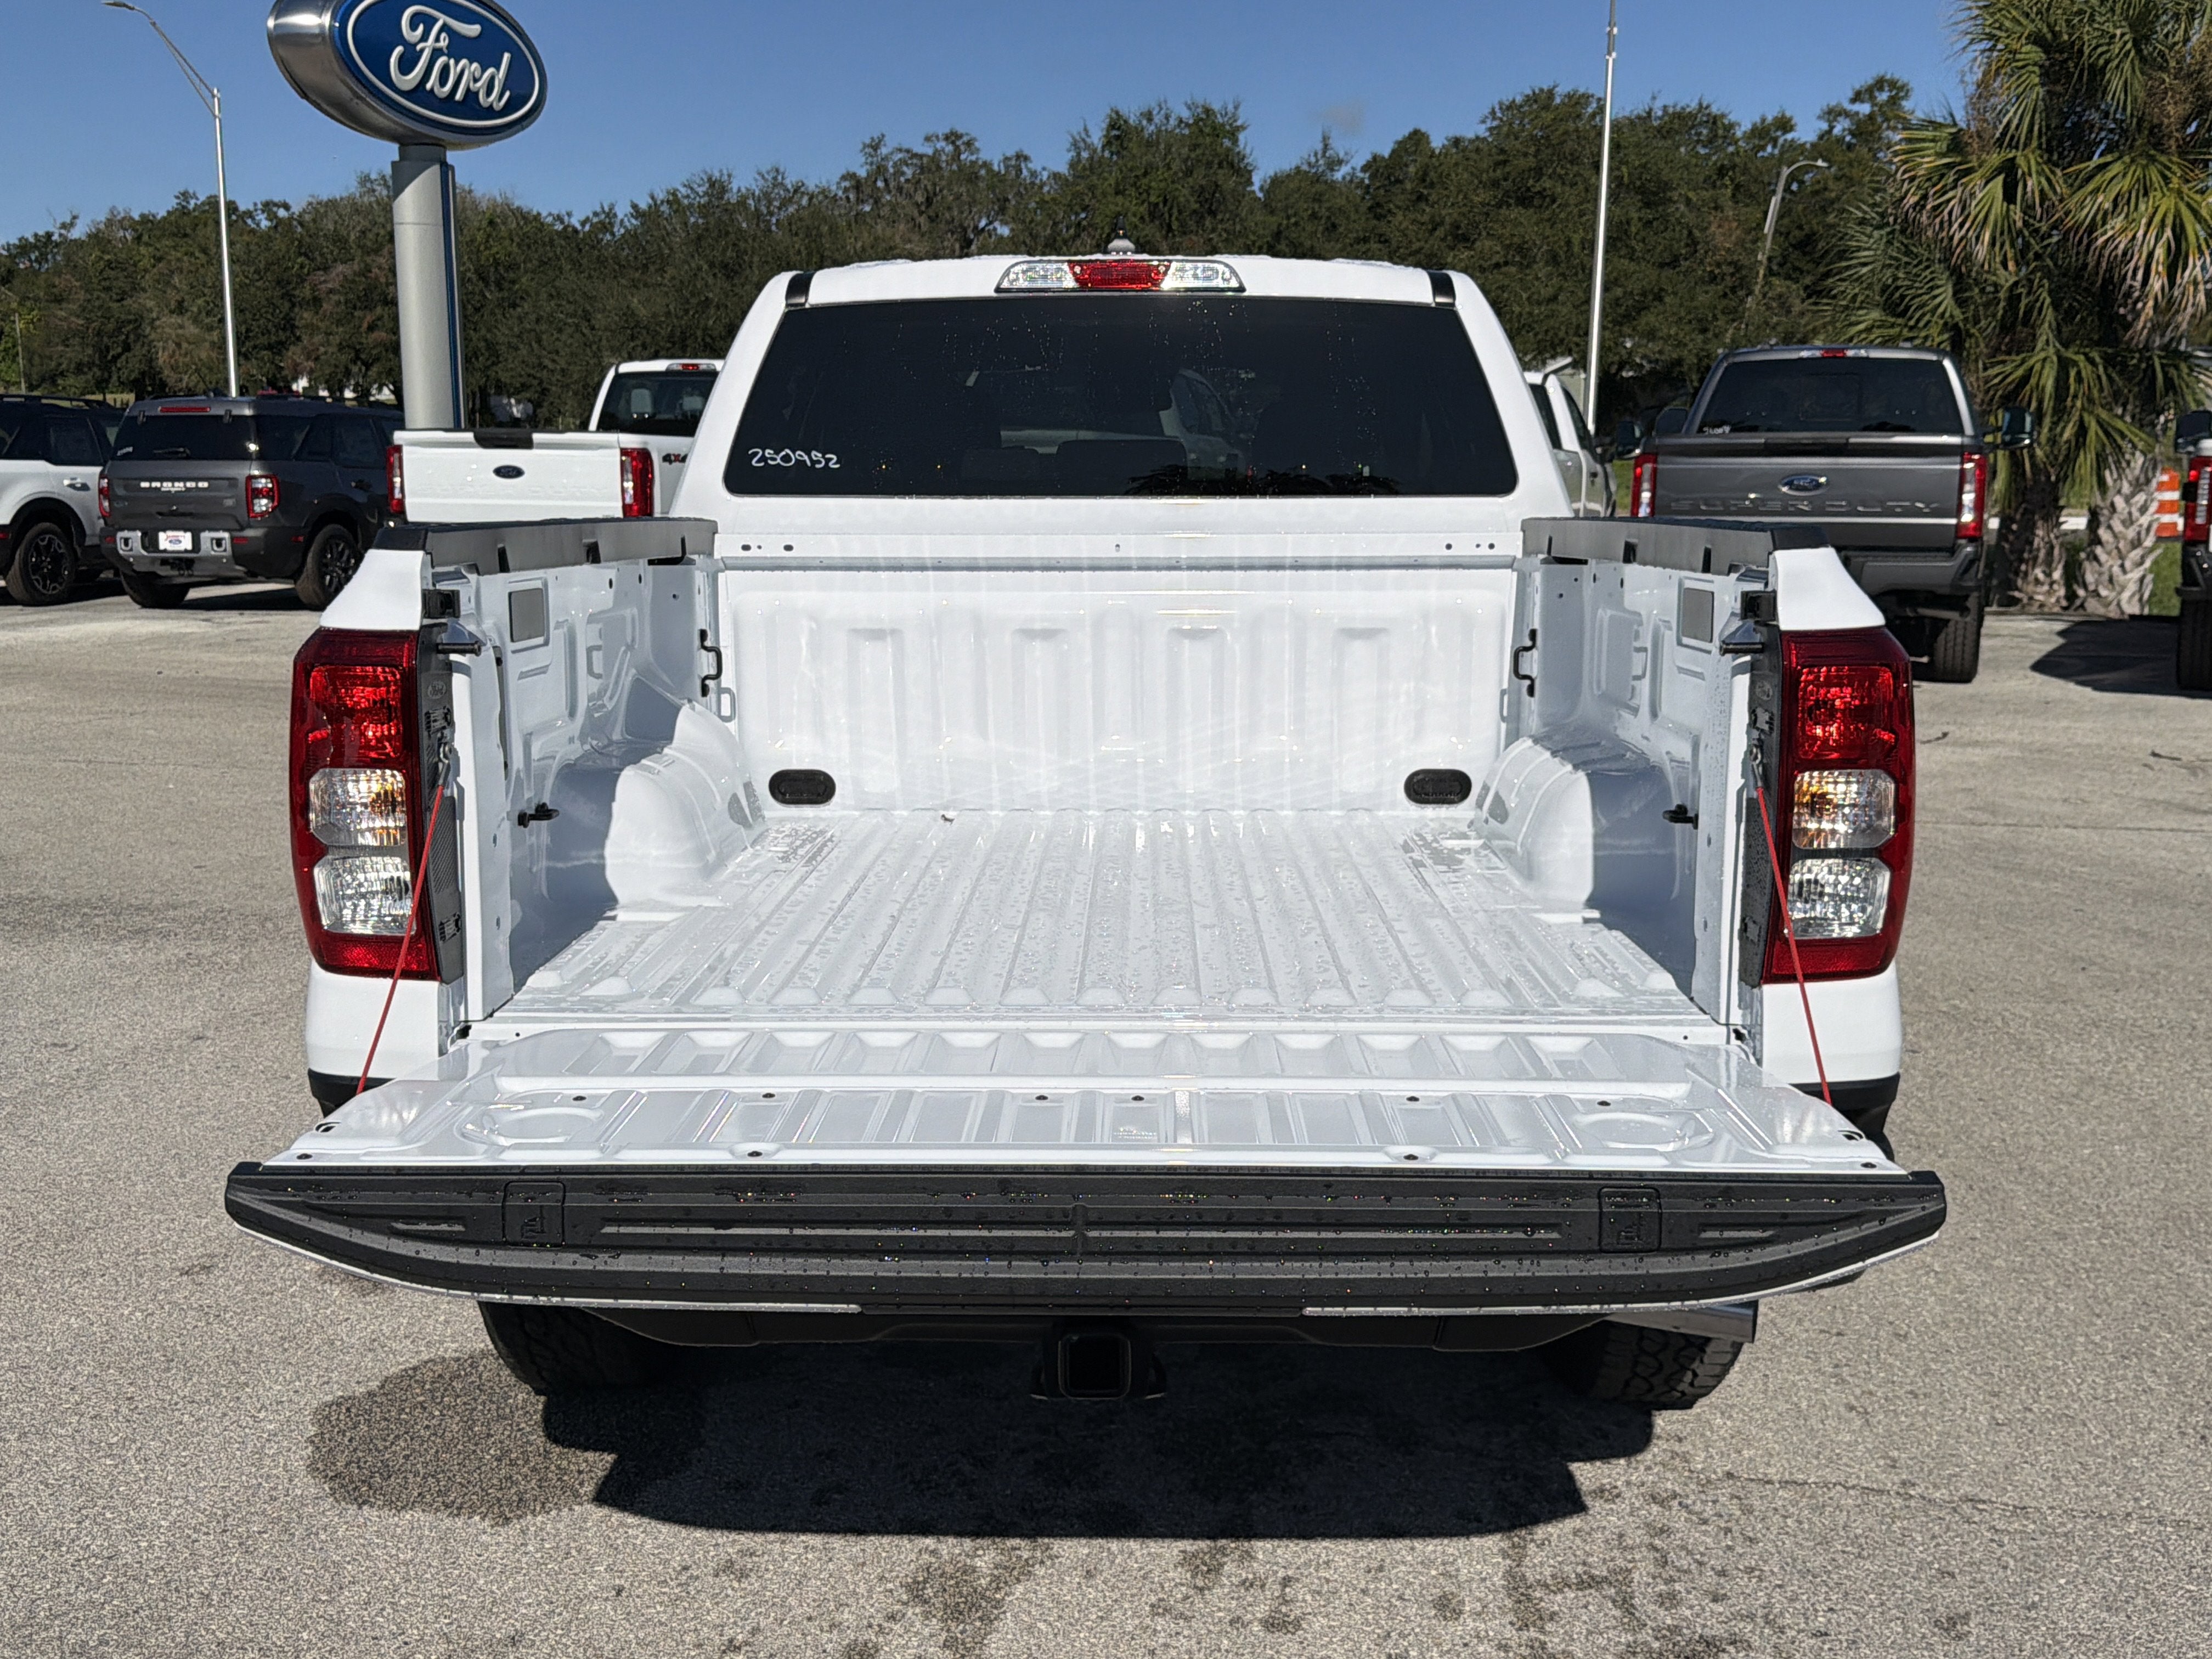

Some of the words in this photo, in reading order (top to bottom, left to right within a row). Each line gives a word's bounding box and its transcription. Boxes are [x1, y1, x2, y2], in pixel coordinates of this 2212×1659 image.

[390, 5, 511, 110] Ford
[748, 448, 841, 469] 250952
[1671, 499, 1812, 512] SUPER
[1825, 500, 1940, 512] DUTY
